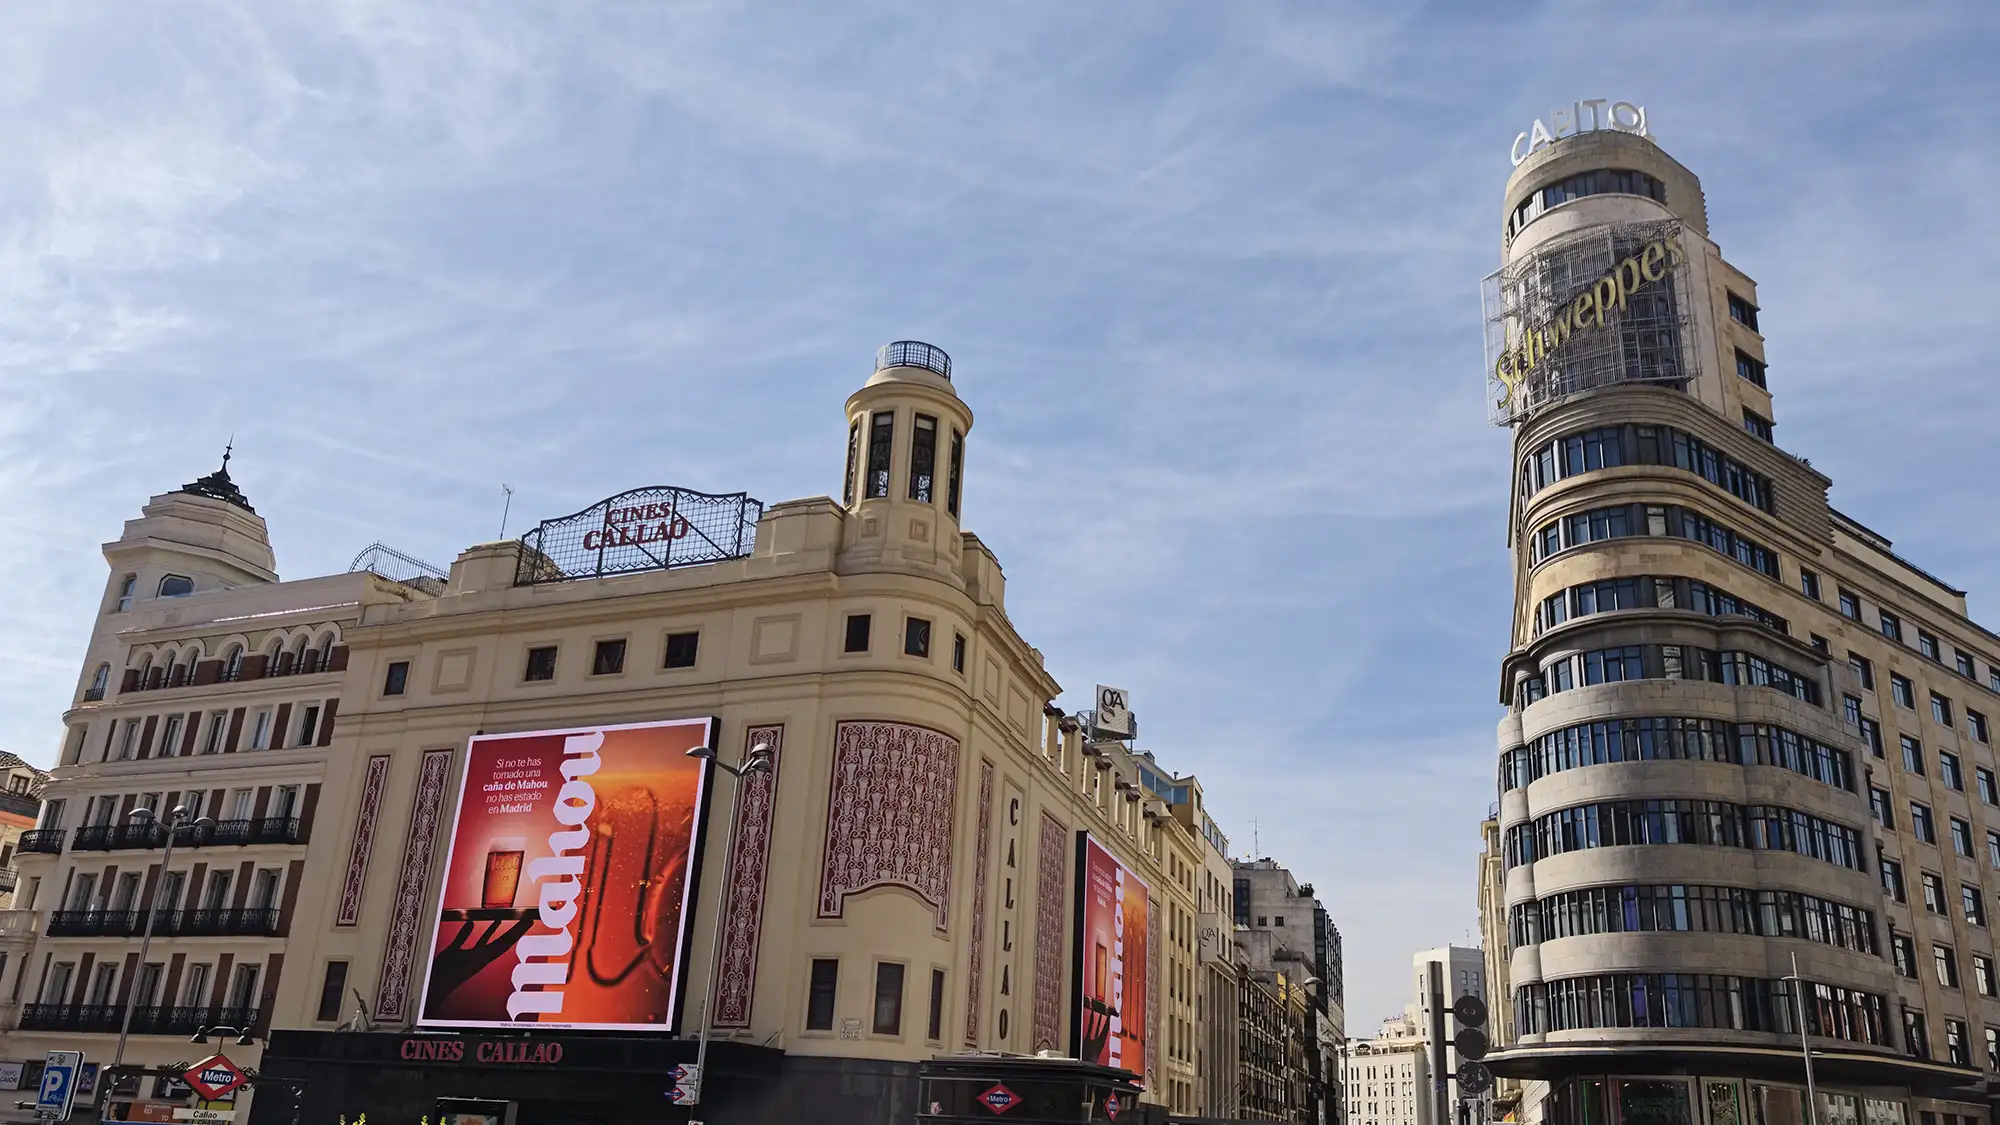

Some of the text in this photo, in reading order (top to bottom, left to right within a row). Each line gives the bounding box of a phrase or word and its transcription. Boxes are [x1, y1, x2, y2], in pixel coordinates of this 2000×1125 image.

[1511, 98, 1656, 167] CAPITOL
[1497, 228, 1688, 408] Schweppes
[605, 501, 671, 525] CINES
[583, 519, 689, 551] CALLAO
[496, 757, 542, 769] Si no te has
[493, 769, 541, 780] tomado una
[483, 782, 504, 792] caña
[505, 781, 516, 791] de
[486, 791, 542, 803] no has estado
[488, 805, 499, 815] en
[506, 730, 605, 1022] mahou
[999, 797, 1019, 1041] CALLAO
[401, 1039, 563, 1064] CINES CALLAO
[42, 1070, 63, 1101] P
[203, 1070, 232, 1083] Metro
[989, 1095, 1009, 1103] Metro
[193, 1110, 218, 1120] Callao
